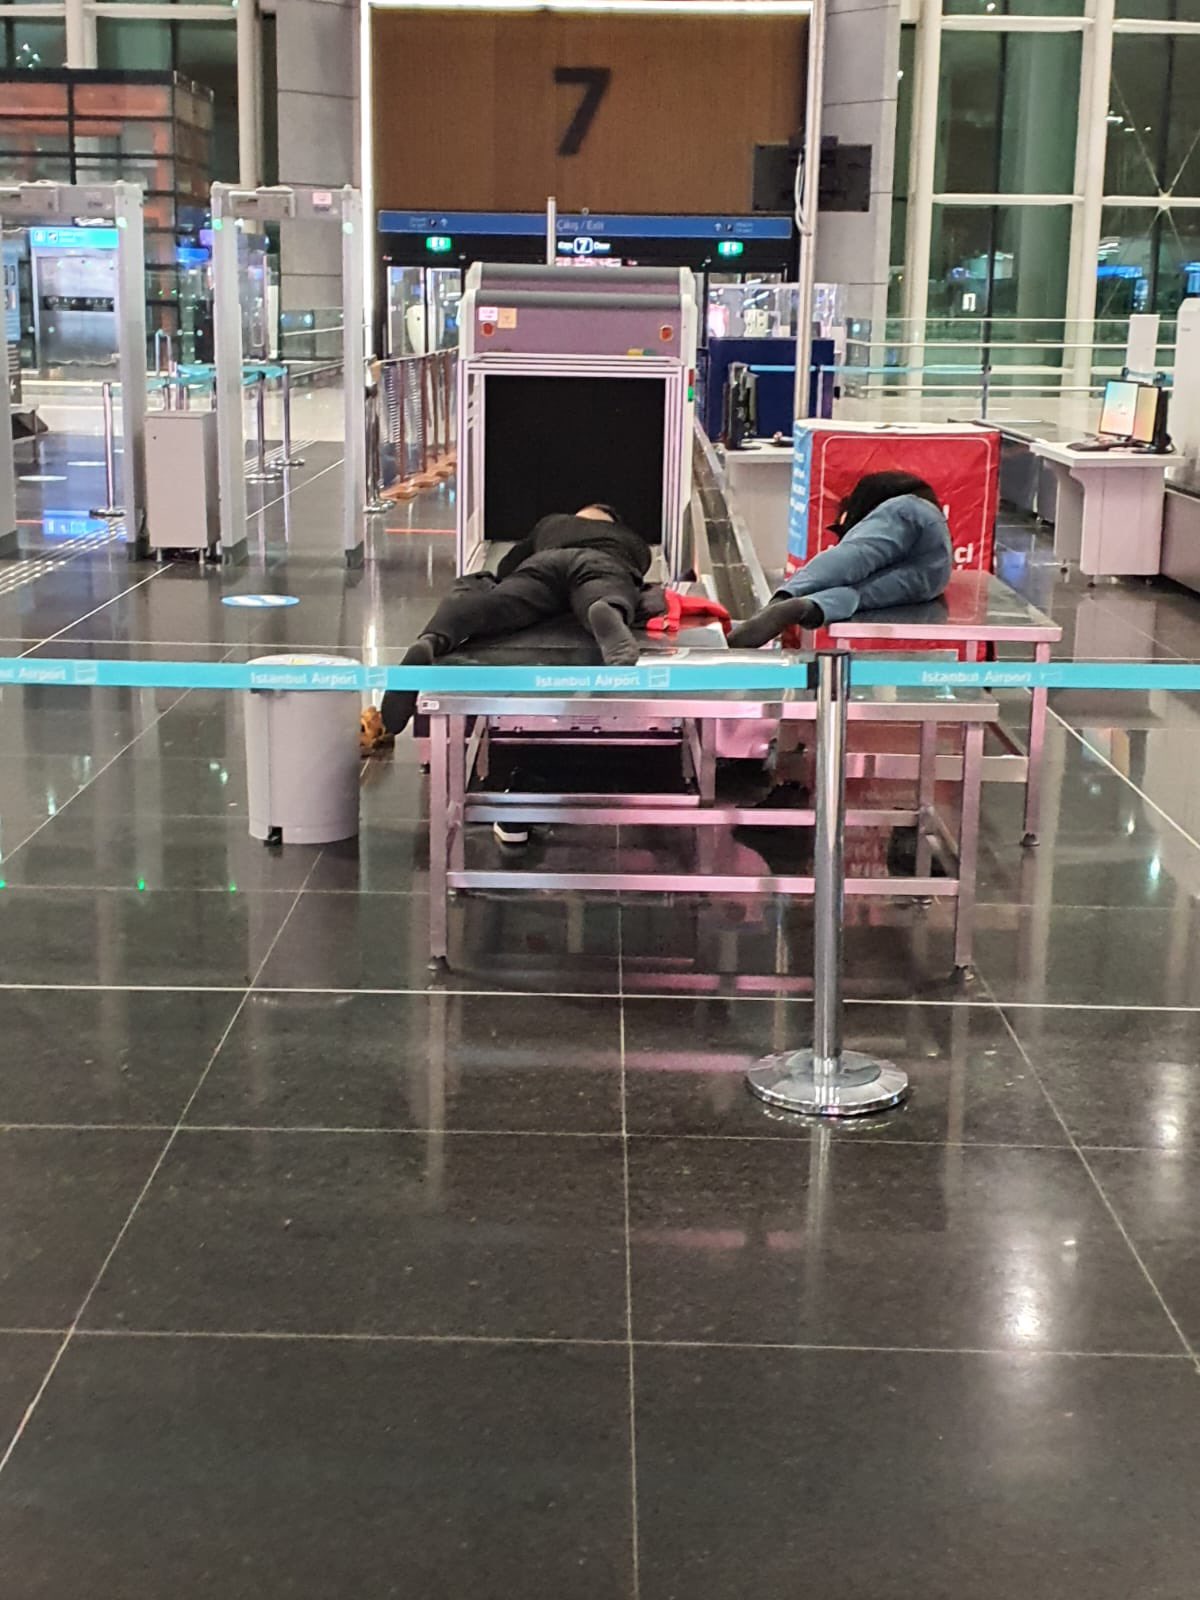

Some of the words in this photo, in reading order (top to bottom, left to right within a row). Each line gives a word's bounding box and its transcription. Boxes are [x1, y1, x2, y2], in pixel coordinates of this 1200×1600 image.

[552, 66, 611, 156] 7
[18, 666, 66, 682] Airport
[250, 671, 307, 685] Istanbul
[311, 671, 358, 687] Airport
[535, 674, 591, 688] Istanbul
[594, 673, 640, 689] Airport
[922, 670, 979, 684] Istanbul
[982, 669, 1032, 685] Airport
